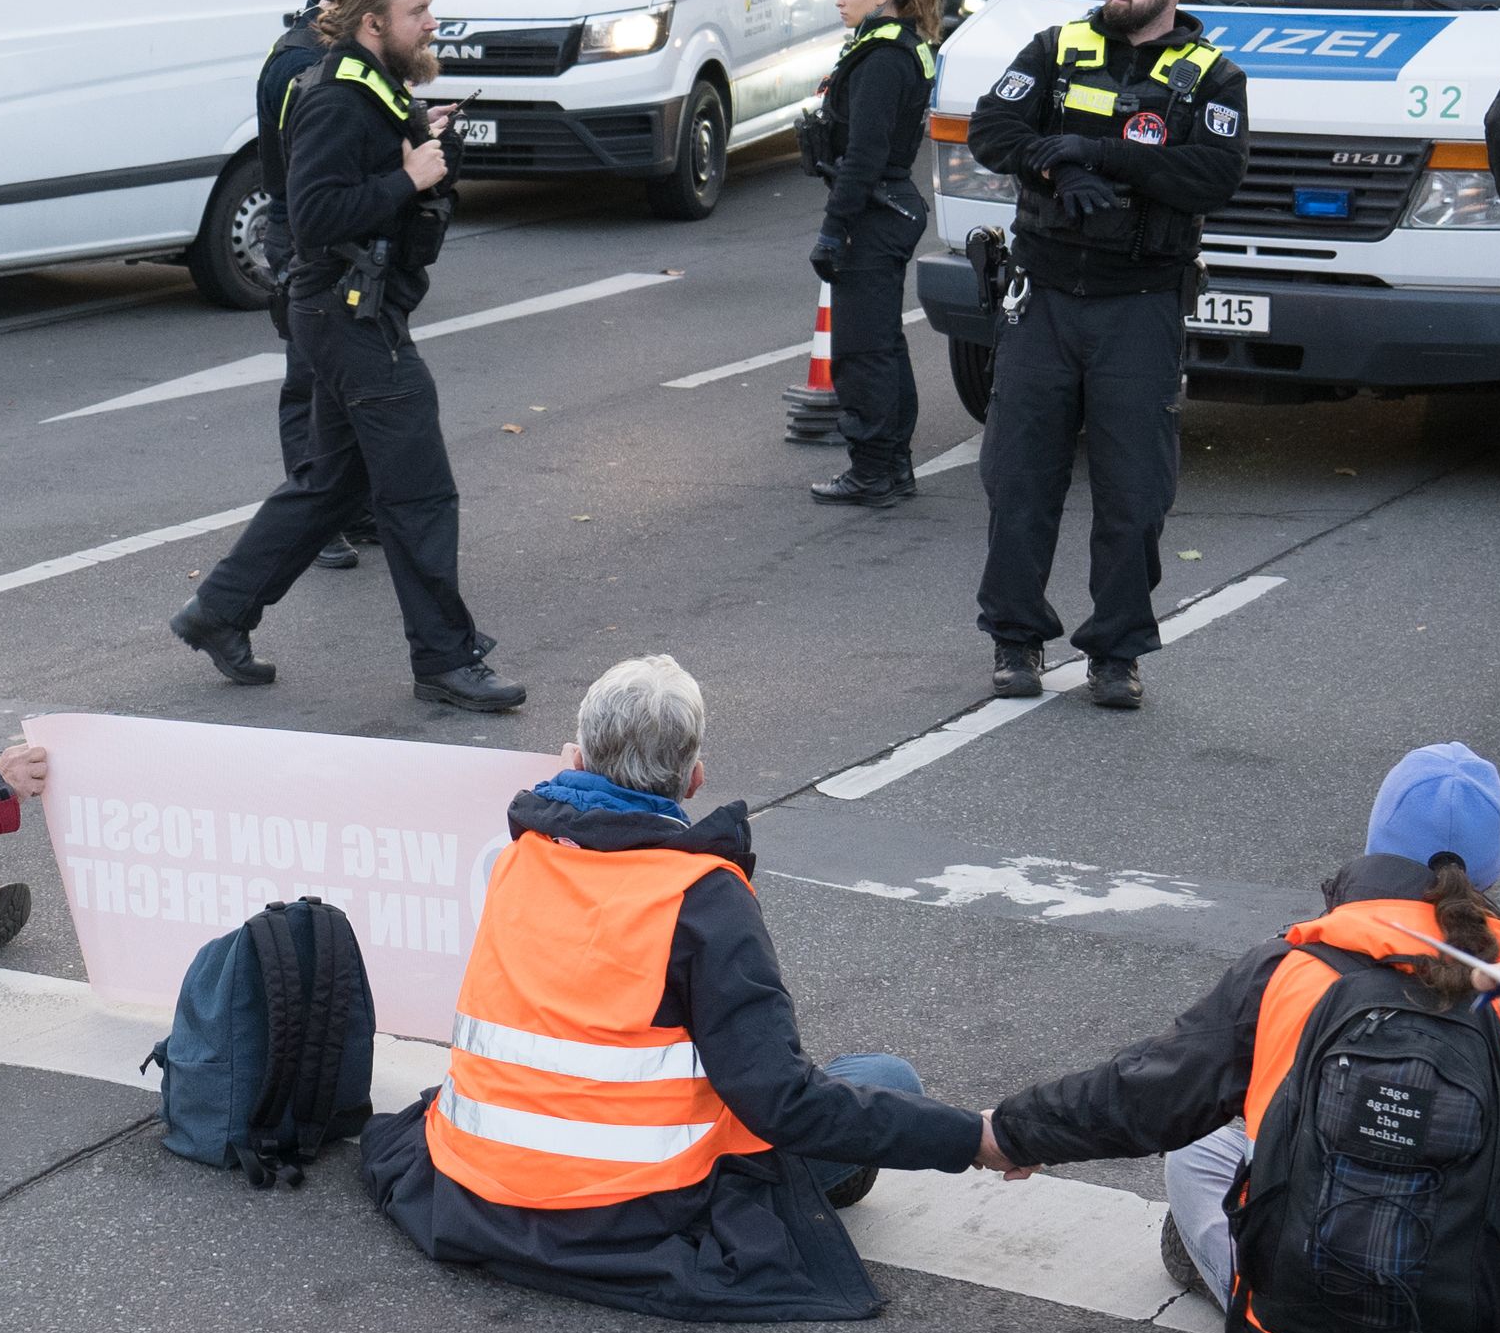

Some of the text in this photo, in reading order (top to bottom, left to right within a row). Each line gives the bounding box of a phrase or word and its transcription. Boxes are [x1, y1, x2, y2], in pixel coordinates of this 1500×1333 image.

[1208, 26, 1401, 59] LIZEI
[1208, 102, 1238, 119] POLIZEI
[1407, 85, 1463, 119] 32
[1332, 152, 1402, 165] 814 D
[1379, 1086, 1410, 1100] rage
[1366, 1099, 1421, 1119] against
[1376, 1115, 1400, 1128] the
[1359, 1126, 1417, 1146] machine.
